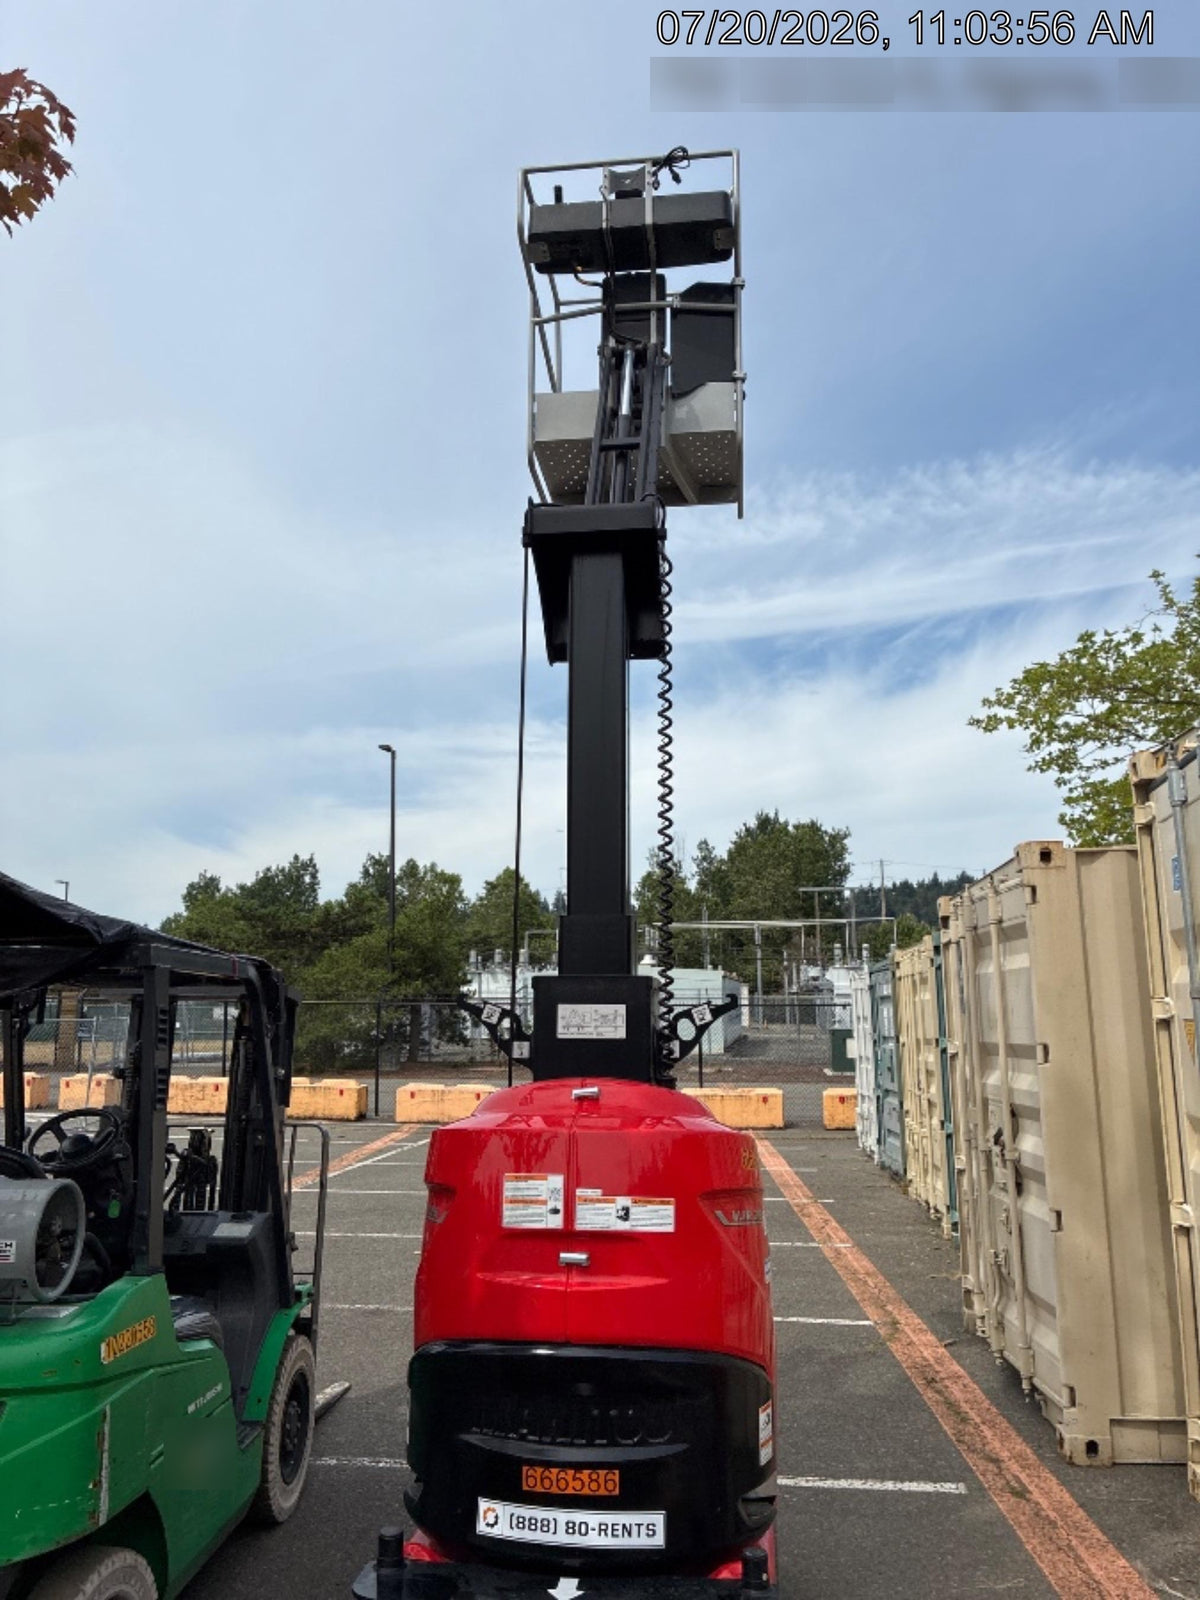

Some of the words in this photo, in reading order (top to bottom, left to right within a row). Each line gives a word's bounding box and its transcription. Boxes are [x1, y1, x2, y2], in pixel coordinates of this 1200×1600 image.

[525, 1467, 617, 1493] 666586
[510, 1513, 557, 1535] (888)
[565, 1519, 656, 1539] 80-RENTS
